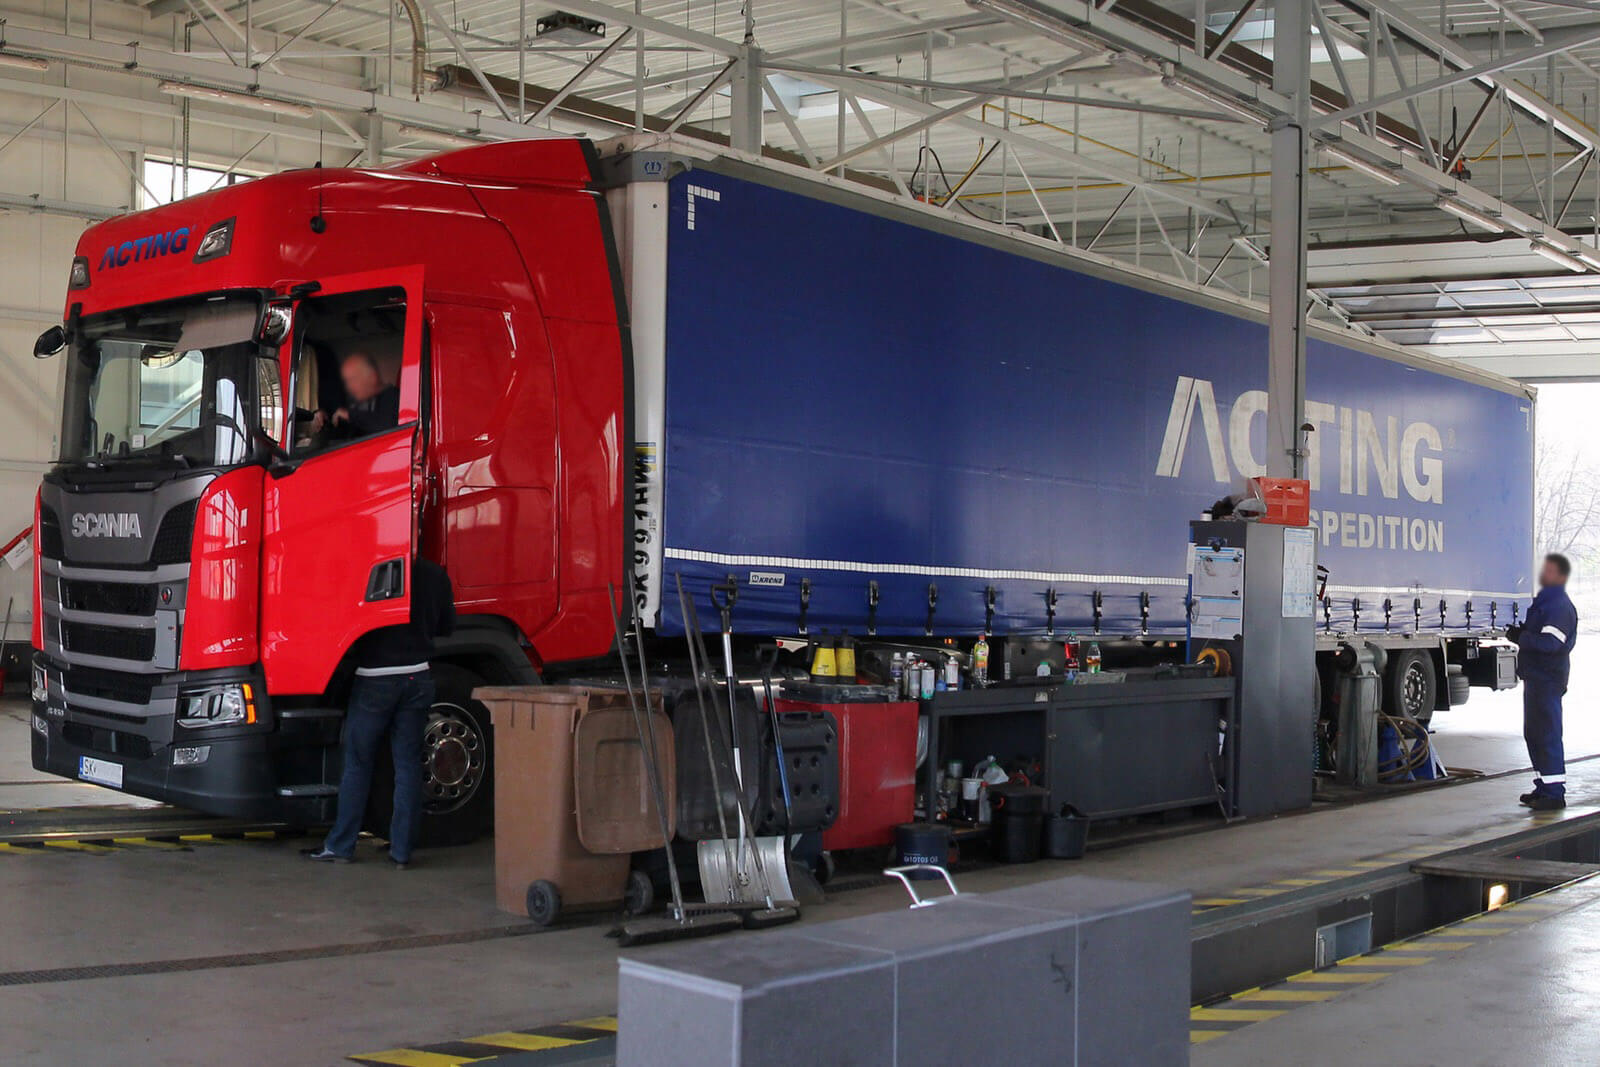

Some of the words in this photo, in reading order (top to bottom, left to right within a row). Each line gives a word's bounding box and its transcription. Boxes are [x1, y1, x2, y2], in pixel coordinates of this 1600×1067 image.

[98, 227, 190, 271] ACTING
[1155, 376, 1444, 505] ACTING
[72, 512, 142, 539] SCANIA
